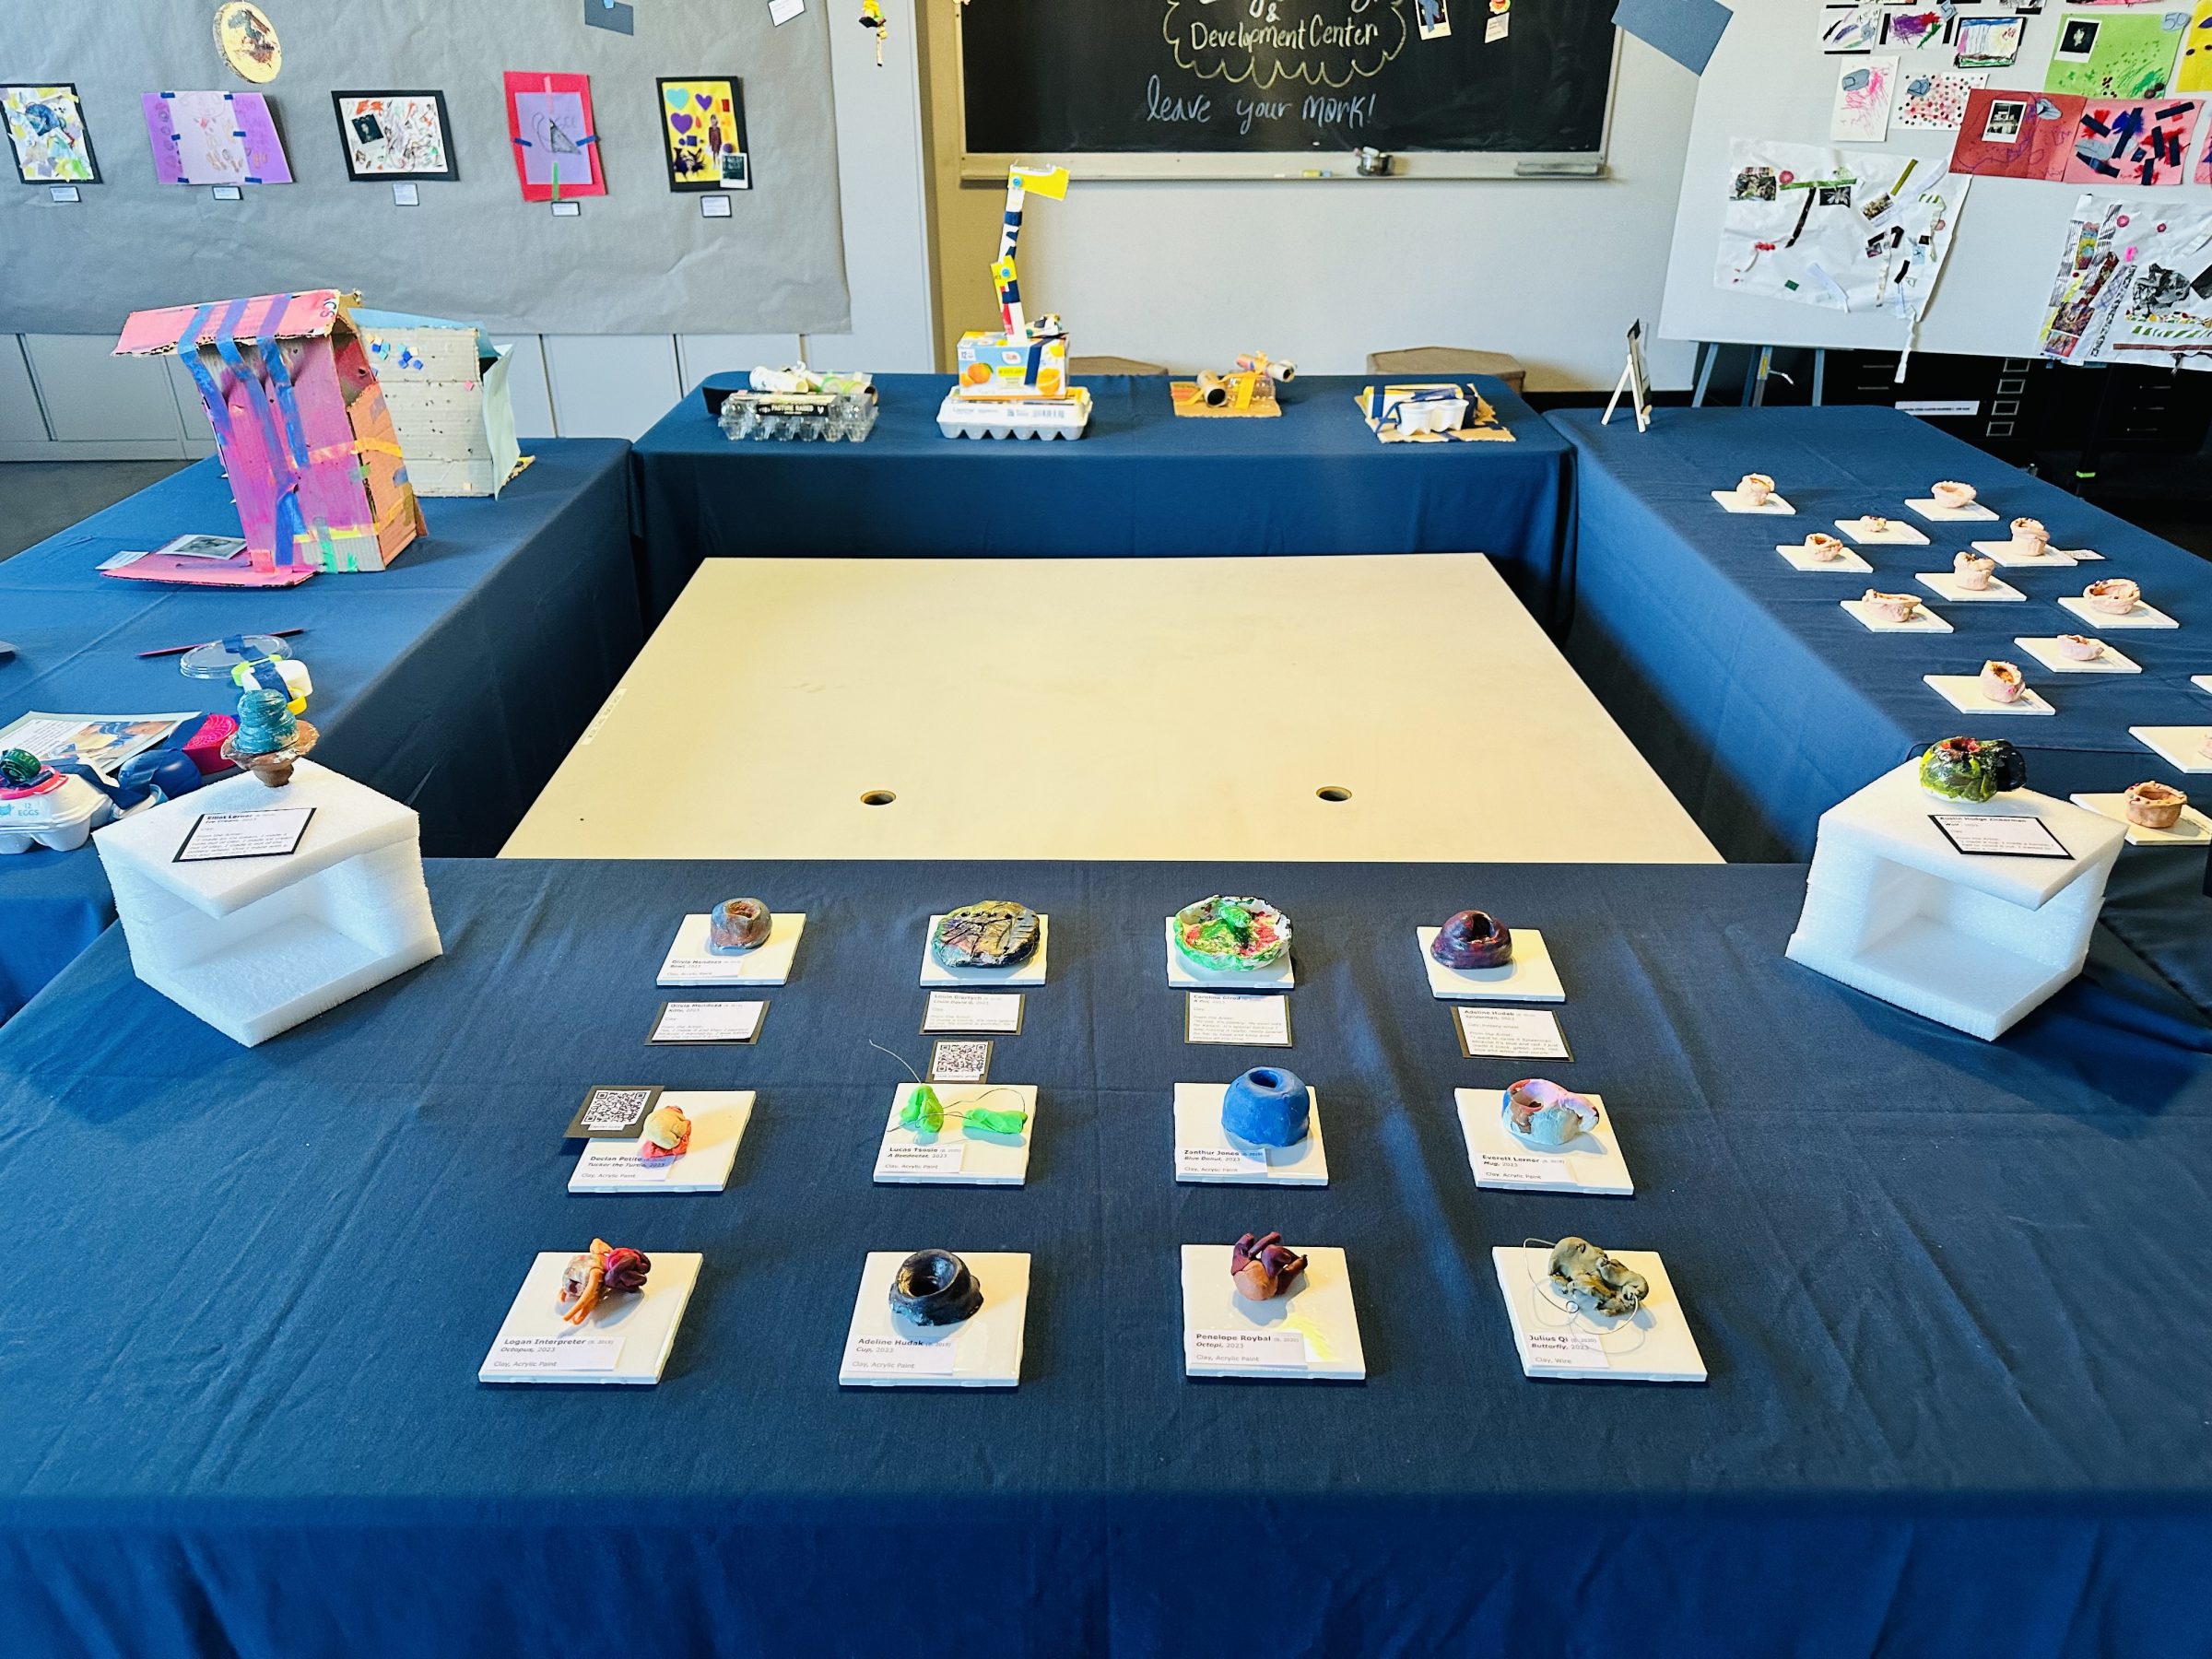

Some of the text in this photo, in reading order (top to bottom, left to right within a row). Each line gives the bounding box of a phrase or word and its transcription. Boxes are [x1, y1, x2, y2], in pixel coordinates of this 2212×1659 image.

[1265, 3, 1281, 22] &
[1191, 14, 1379, 53] Development Center
[1147, 75, 1212, 123] leave
[1236, 98, 1293, 135] your
[852, 1360, 869, 1369] Clay,
[871, 1361, 895, 1370] Acrylic
